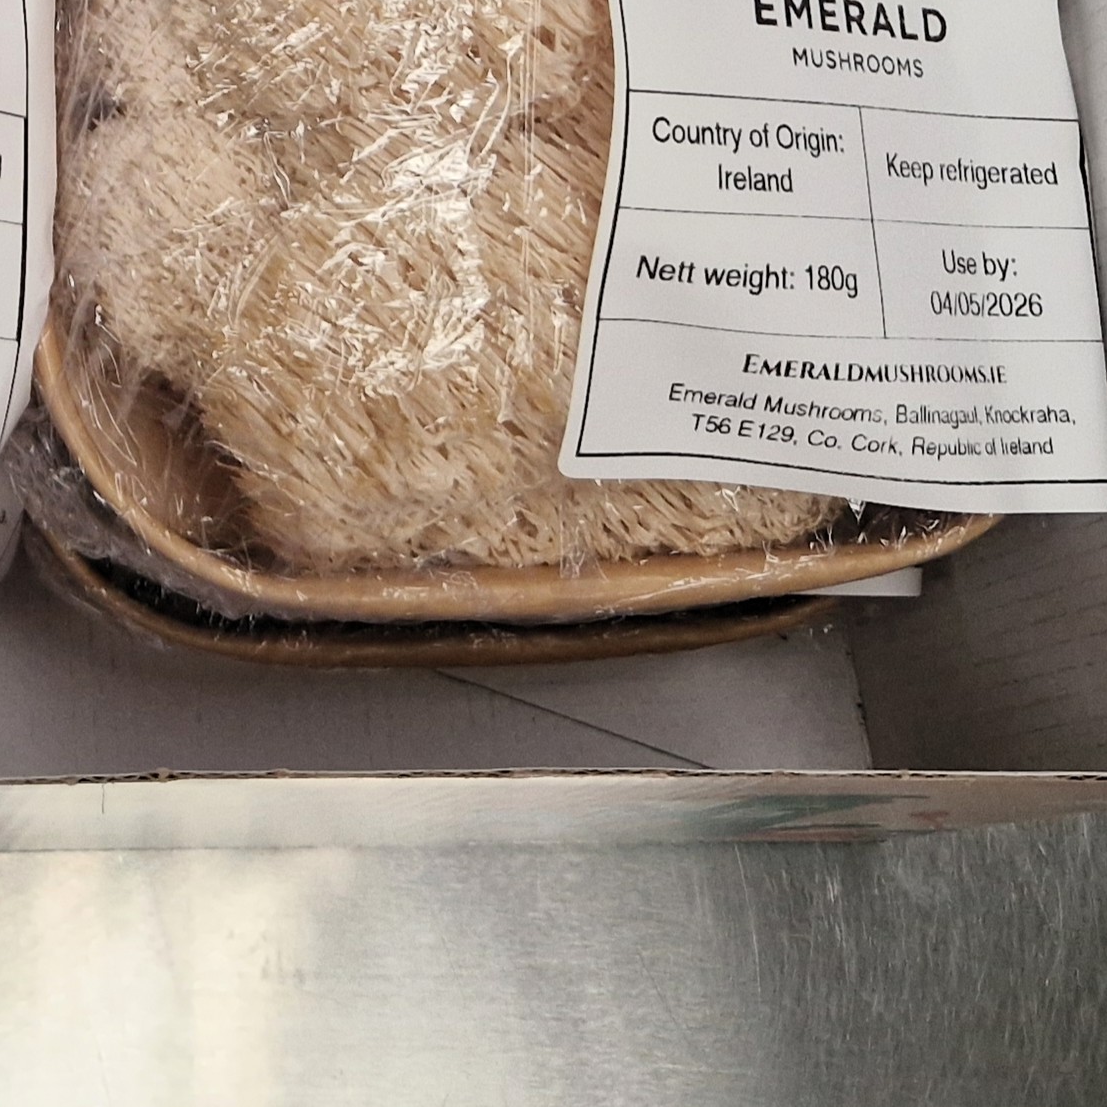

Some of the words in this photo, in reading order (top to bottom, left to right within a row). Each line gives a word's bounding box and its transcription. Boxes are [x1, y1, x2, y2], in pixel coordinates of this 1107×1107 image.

[791, 46, 924, 79] MUSHROOMS
[651, 115, 743, 155] Country
[748, 121, 770, 149] of
[775, 123, 845, 159] Origin:
[717, 162, 794, 194] Ireland
[885, 151, 934, 188] Keep
[939, 157, 1059, 191] refrigerated
[635, 254, 697, 285] Nett
[703, 262, 796, 297] weight:
[804, 263, 859, 300] 180g
[941, 248, 978, 276] Use
[981, 250, 1018, 283] by:
[930, 290, 1044, 318] 04/05/2026
[741, 353, 1008, 385] EMERALDMUSHROOMS.IE
[668, 382, 759, 411] Emerald
[763, 394, 888, 427] Mushrooms,
[895, 403, 983, 430] Ballinagaul,
[984, 404, 1077, 426] Knockraha,
[691, 412, 732, 435] T56
[807, 428, 842, 450] Co.
[850, 433, 903, 457] Cork,
[911, 435, 982, 462] Republic
[999, 436, 1055, 456] Ireland
